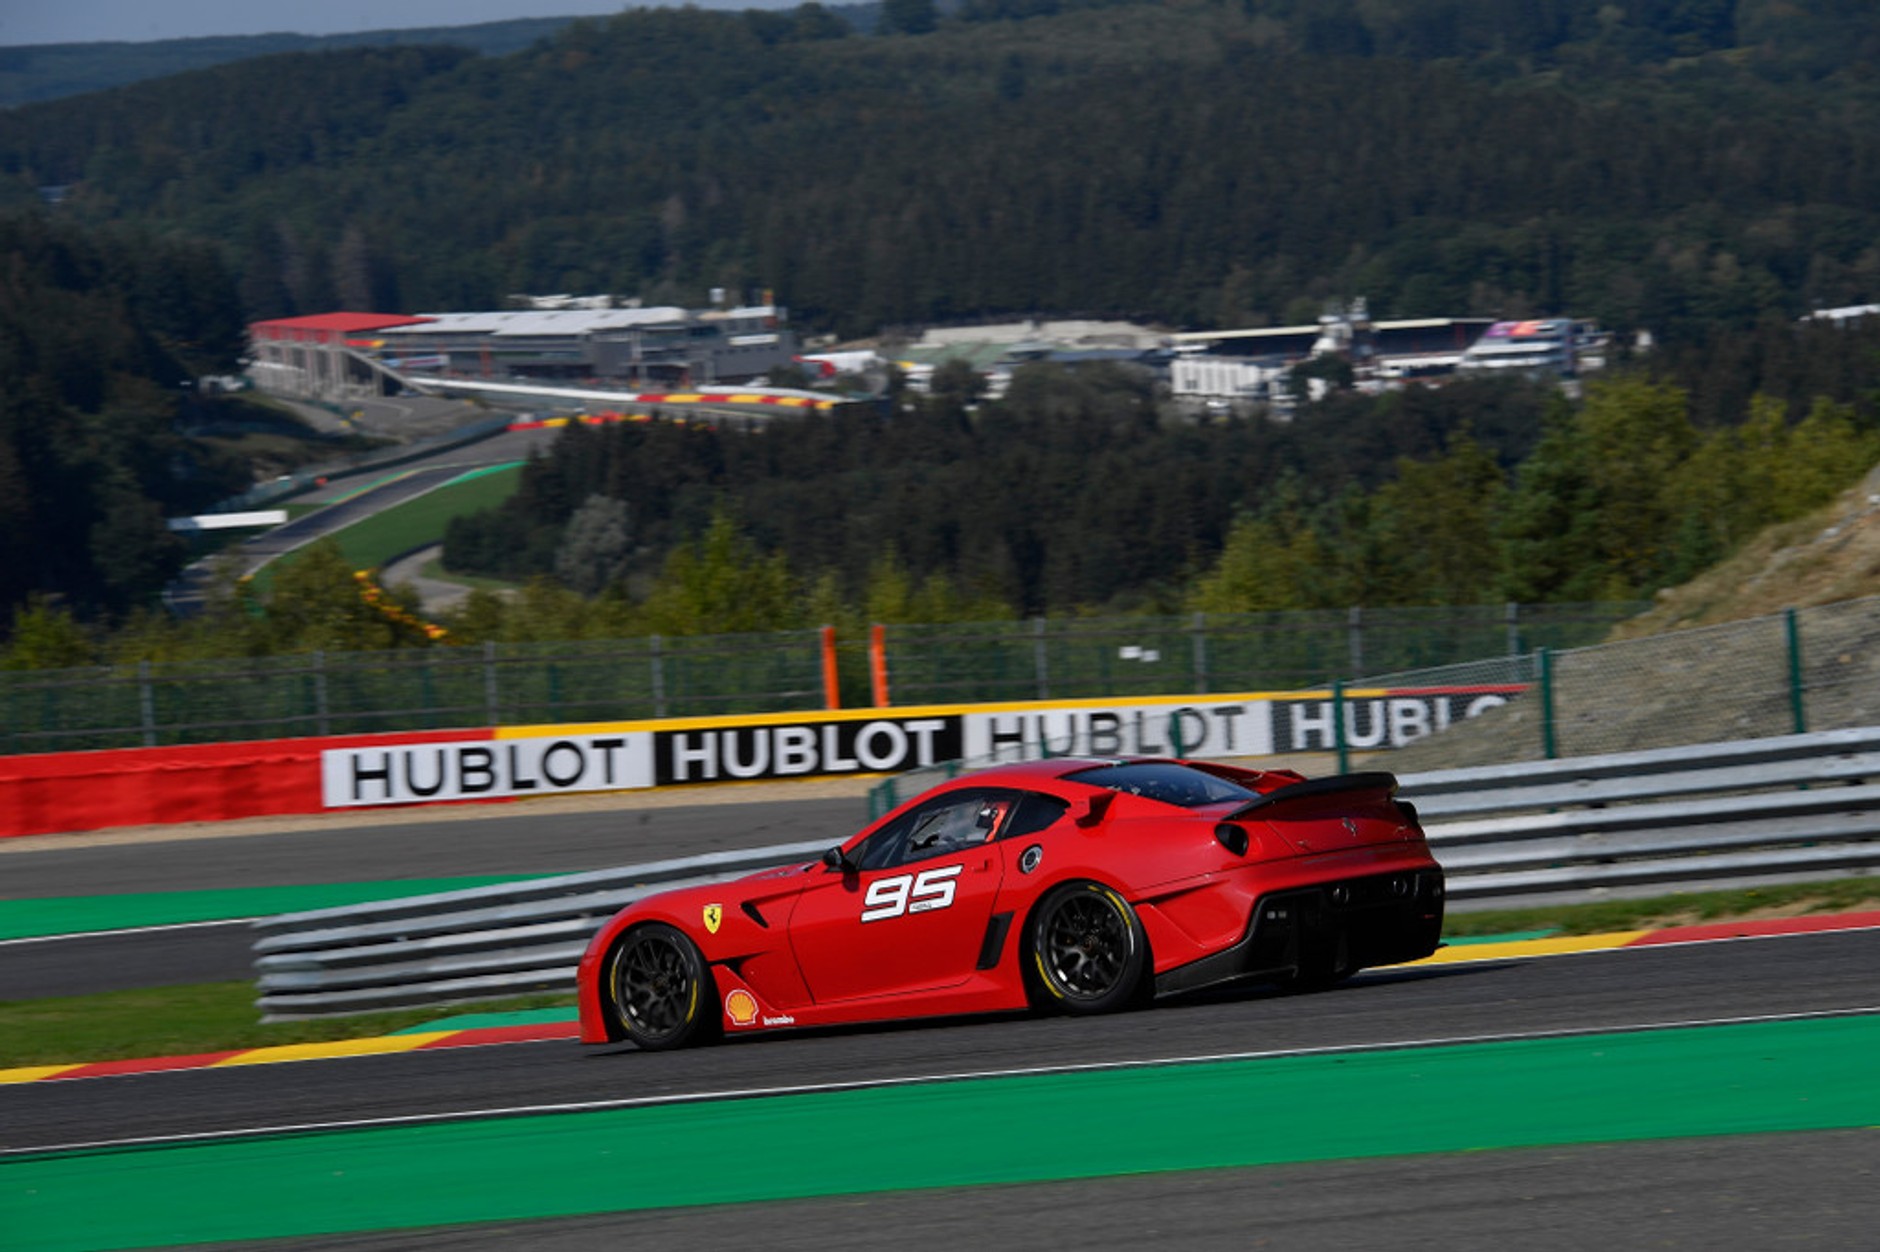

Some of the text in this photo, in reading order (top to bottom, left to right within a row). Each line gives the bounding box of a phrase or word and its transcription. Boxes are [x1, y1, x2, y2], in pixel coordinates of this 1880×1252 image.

[672, 720, 946, 781] HUBLOT
[989, 706, 1244, 762] HUBLOT
[352, 739, 627, 799] HUBLOT
[861, 864, 964, 923] 95
